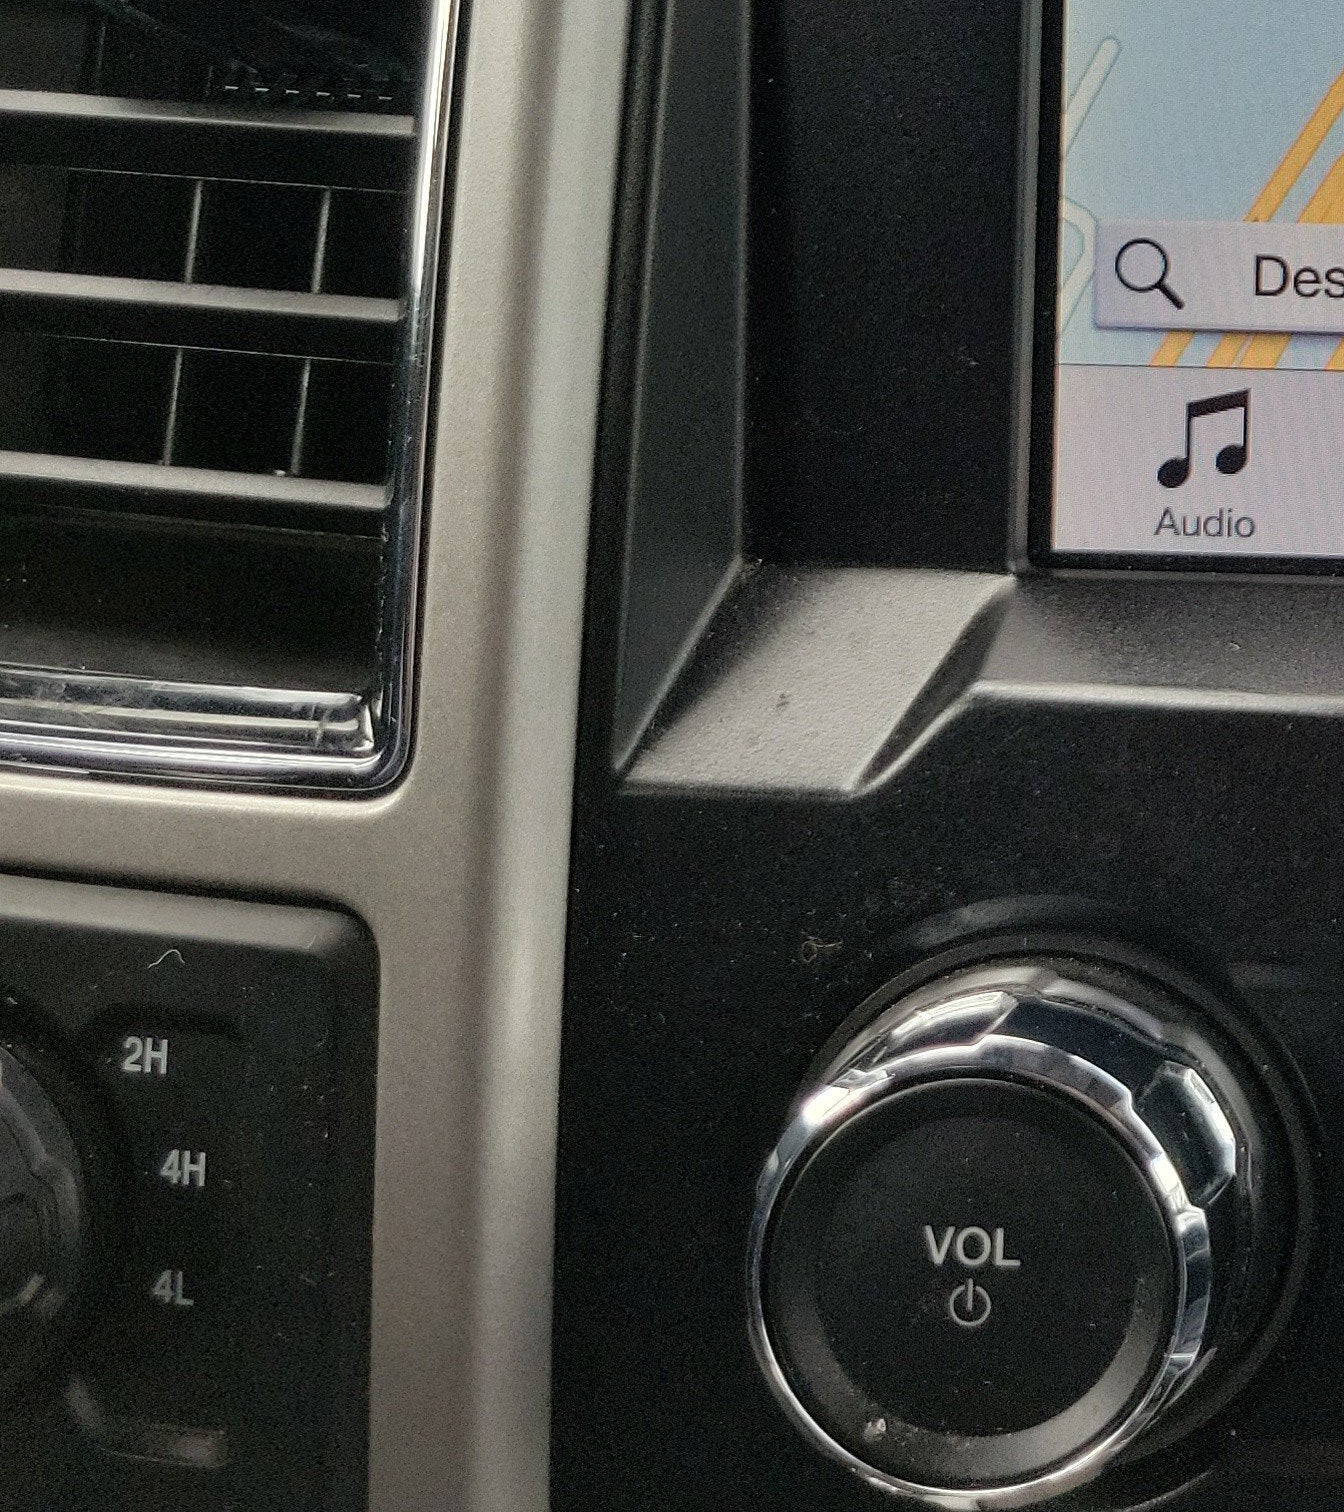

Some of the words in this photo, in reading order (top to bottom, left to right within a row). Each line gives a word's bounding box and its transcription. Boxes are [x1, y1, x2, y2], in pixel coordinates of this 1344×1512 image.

[1153, 507, 1257, 541] Audio
[121, 1035, 170, 1075] 2H
[159, 1149, 207, 1188] 4H
[925, 1225, 1021, 1268] VOL
[153, 1271, 195, 1307] 4L
